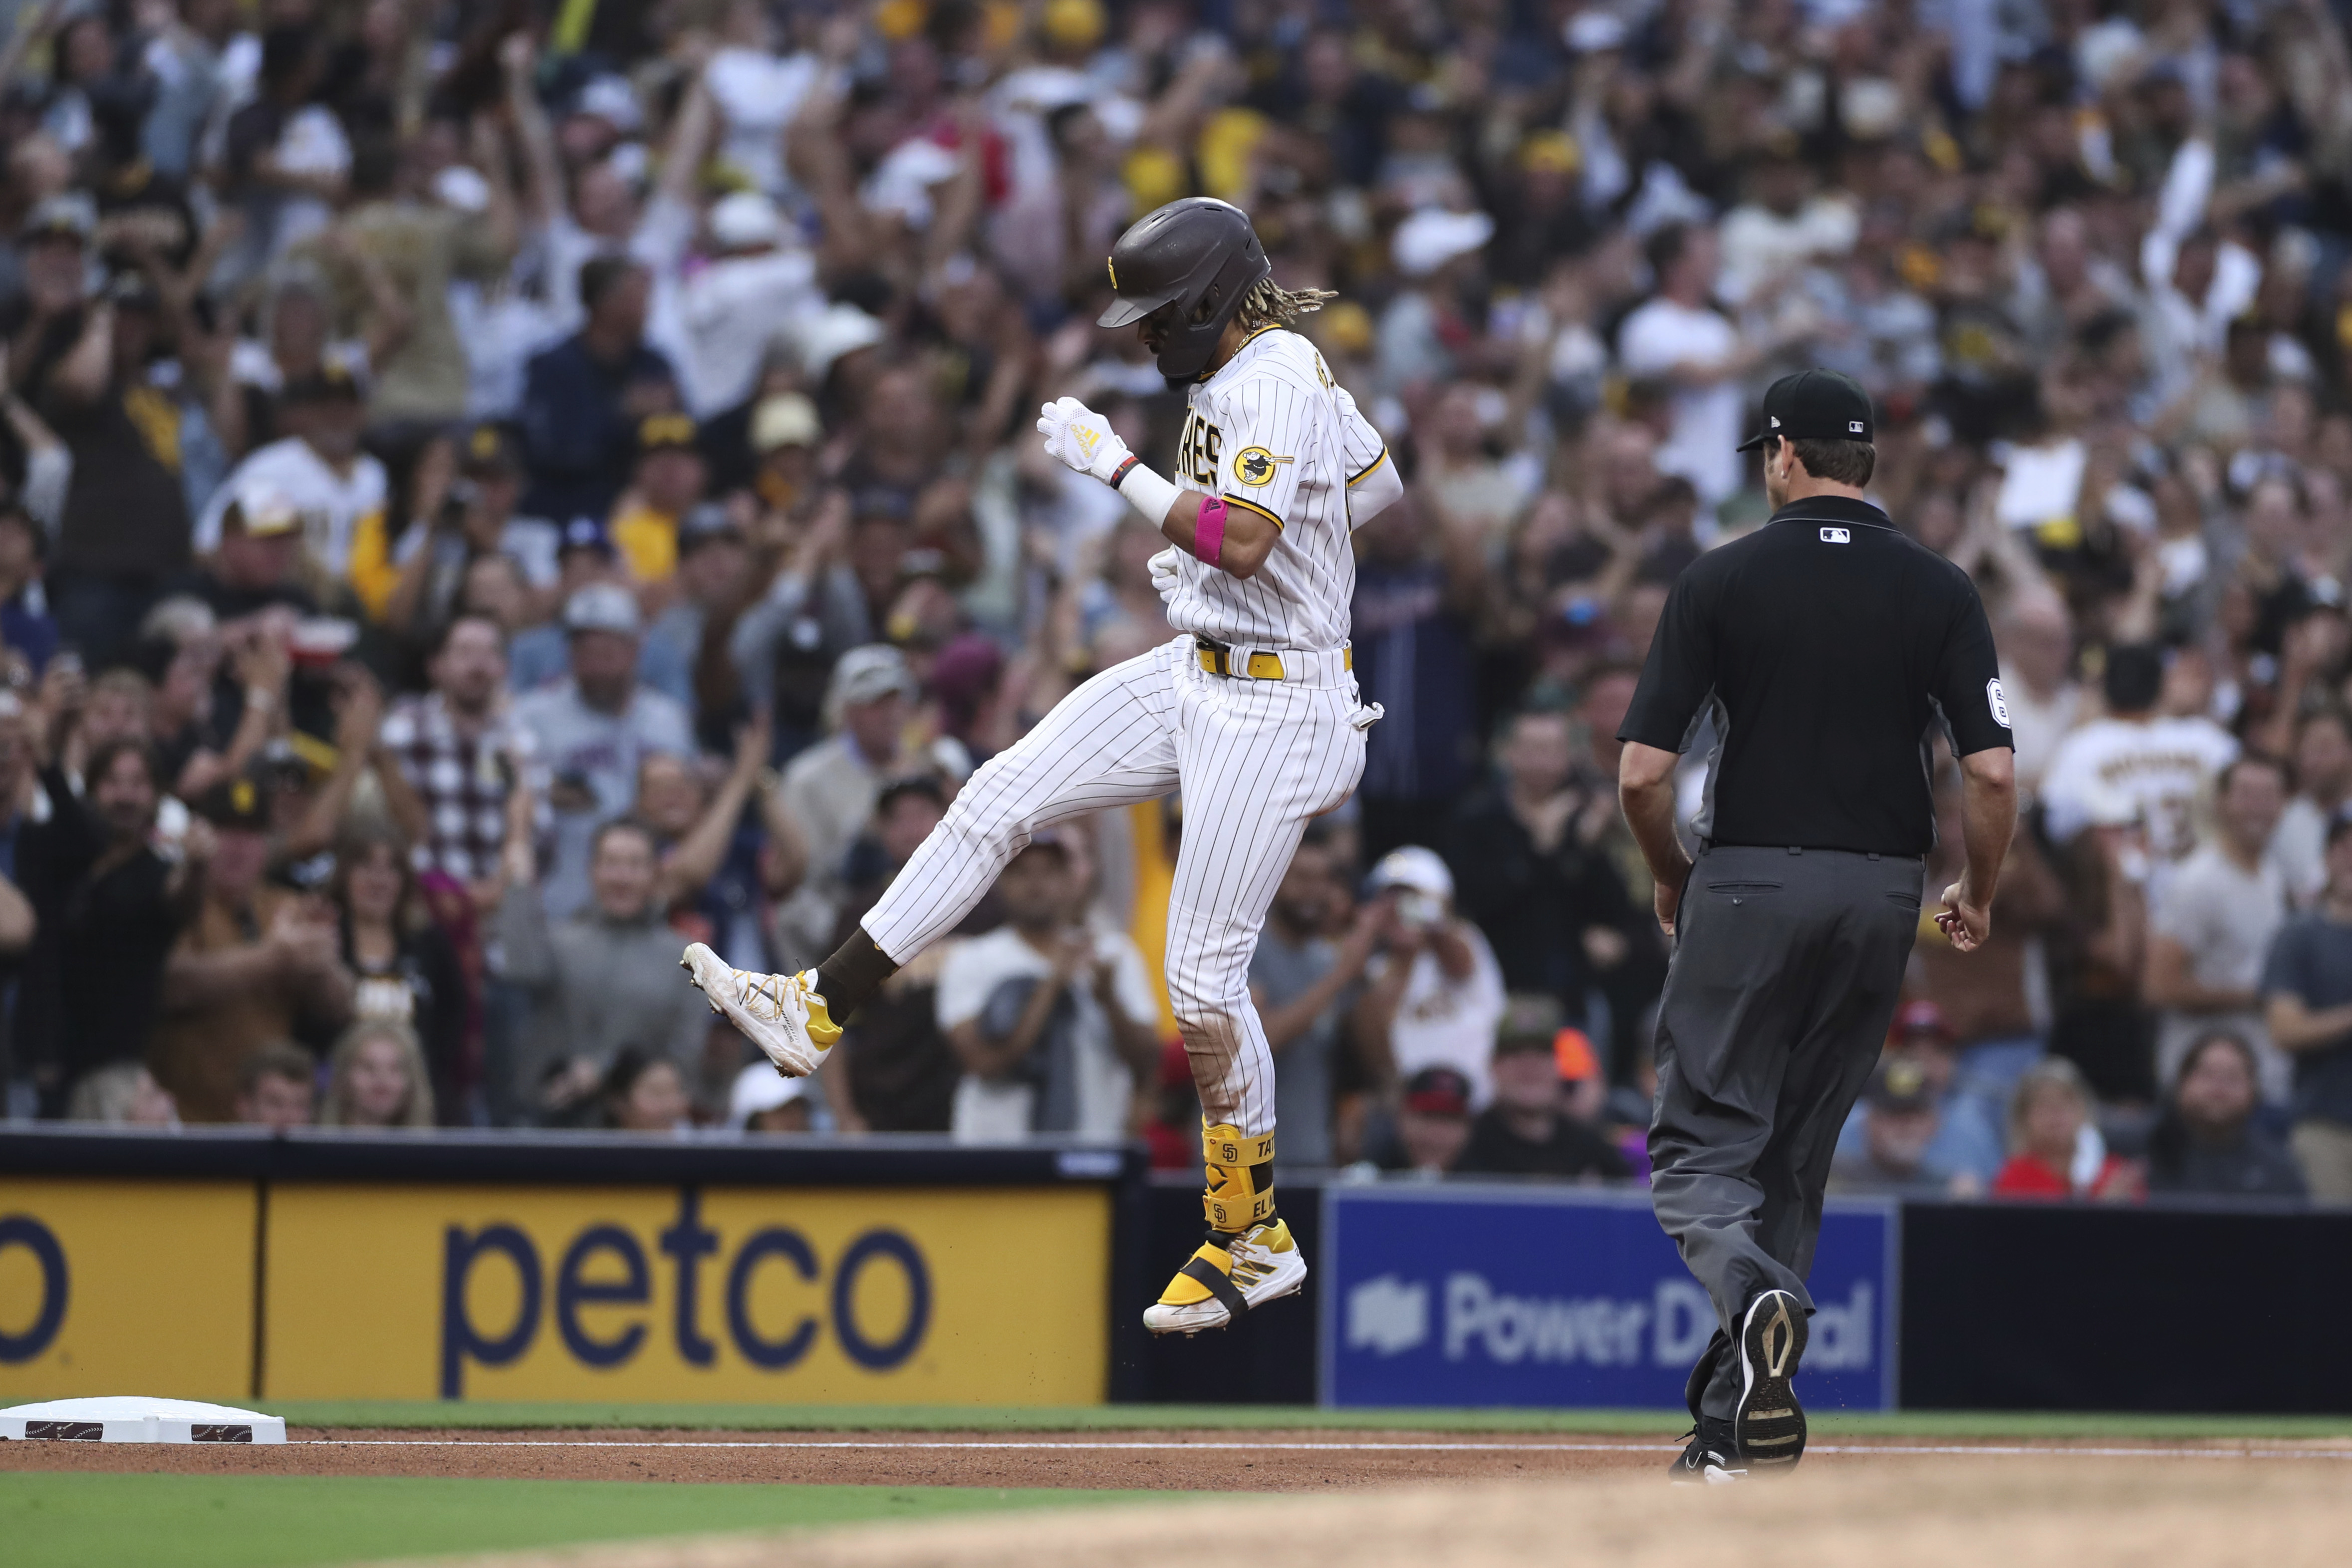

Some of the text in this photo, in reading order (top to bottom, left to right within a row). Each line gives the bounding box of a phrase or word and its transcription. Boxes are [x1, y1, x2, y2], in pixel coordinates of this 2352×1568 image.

[1070, 424, 1091, 458] adidas
[1223, 1143, 1238, 1163] SD
[1214, 1203, 1227, 1223] SD
[1253, 1199, 1267, 1218] EL
[439, 1187, 933, 1399] petco
